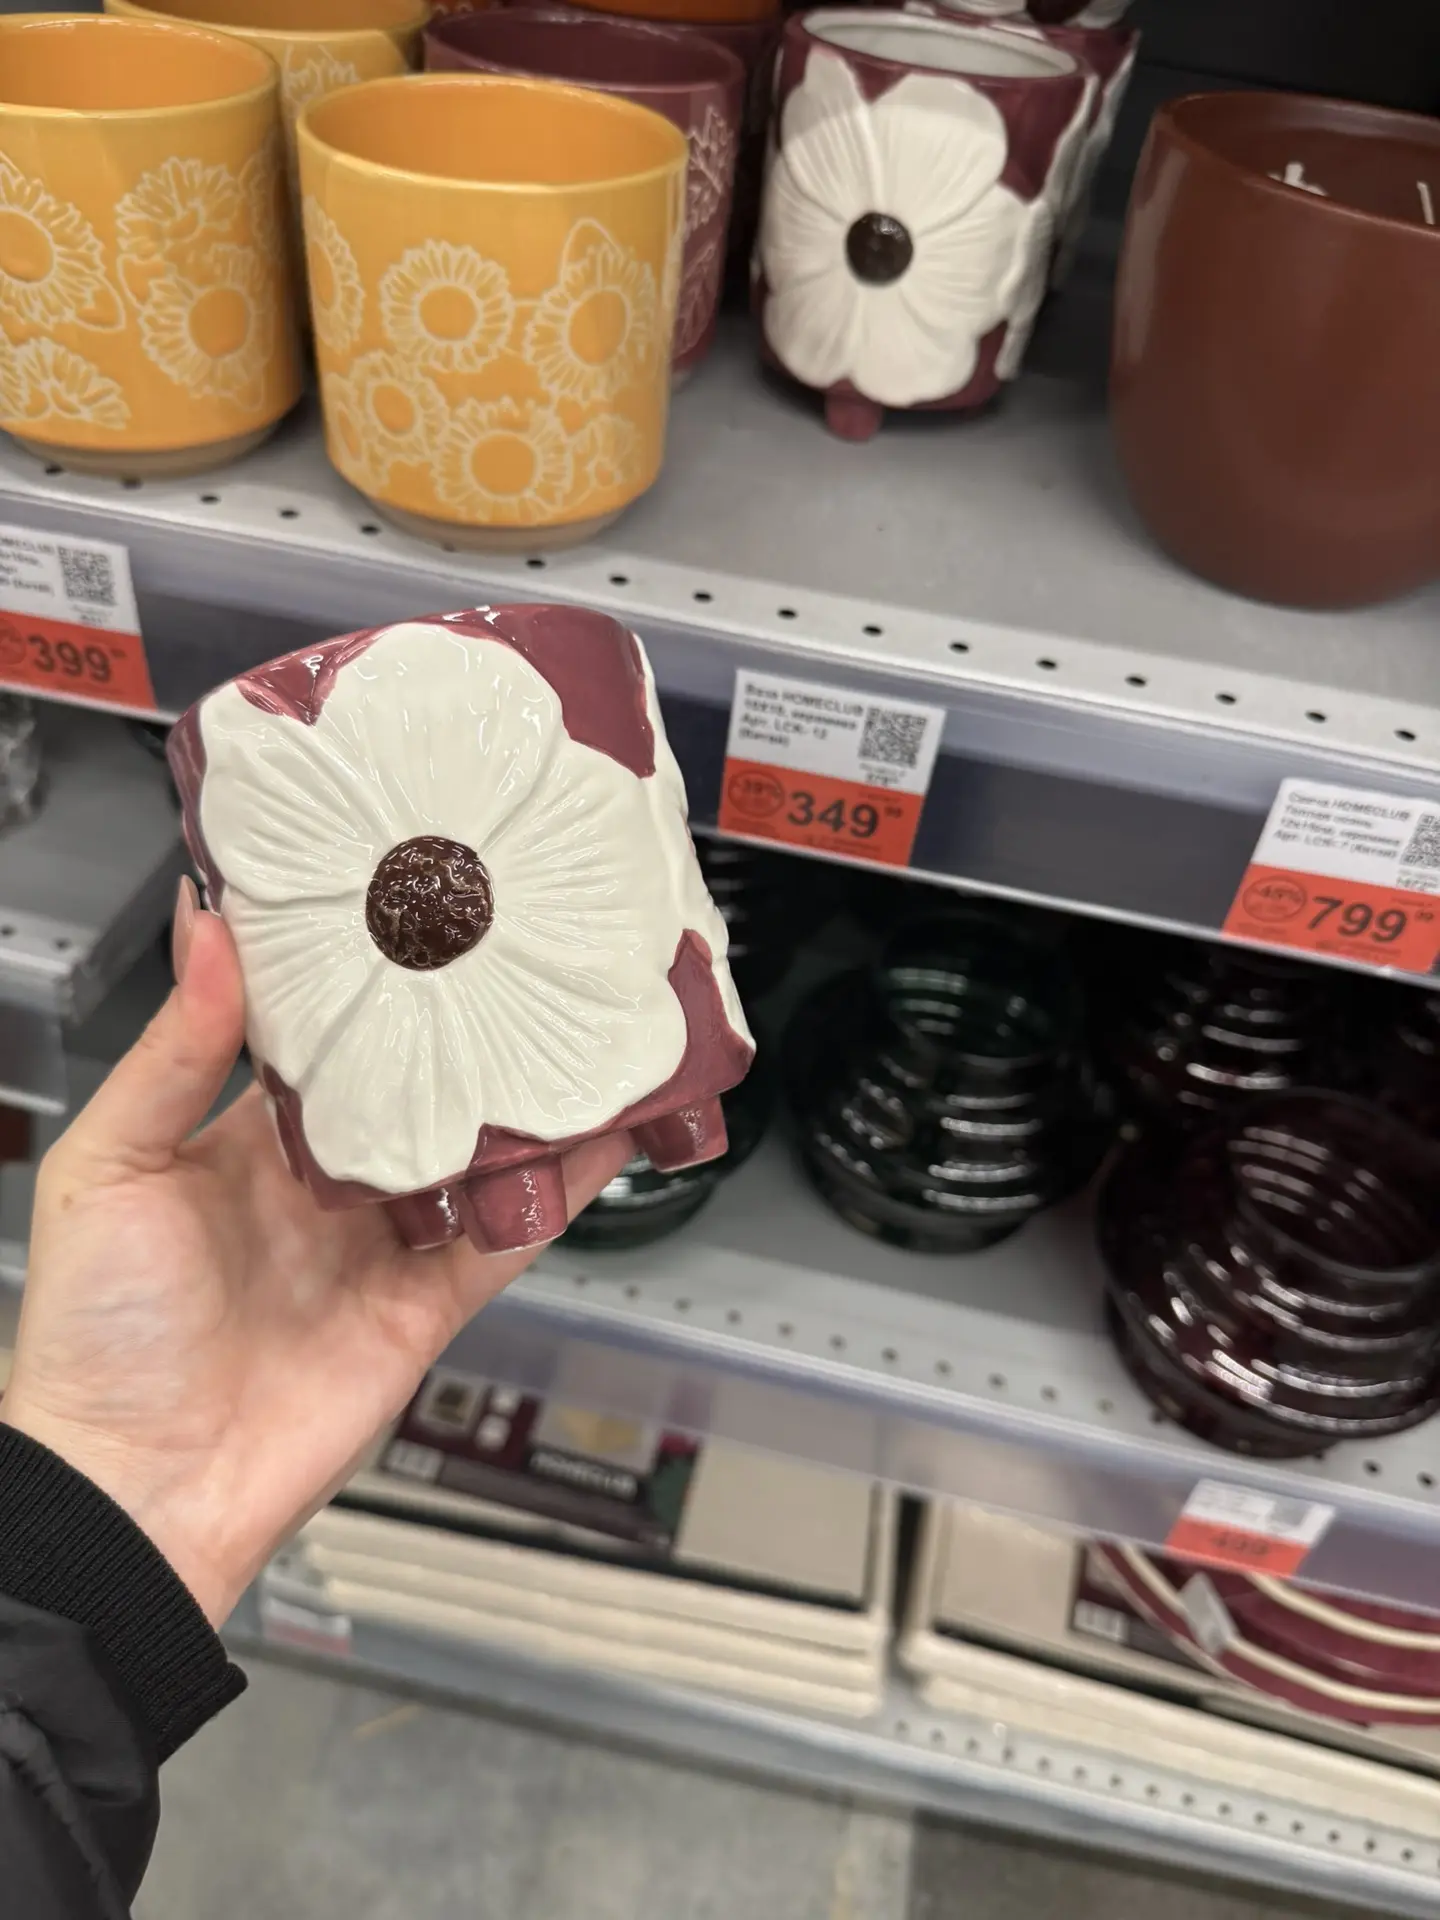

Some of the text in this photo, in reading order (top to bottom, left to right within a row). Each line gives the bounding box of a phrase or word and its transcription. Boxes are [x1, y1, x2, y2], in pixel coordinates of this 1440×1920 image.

[28, 633, 112, 683] 399
[780, 690, 863, 717] HOMECLUB
[787, 790, 880, 840] 349
[1331, 800, 1412, 822] HOMECLUB
[1308, 895, 1408, 943] 799
